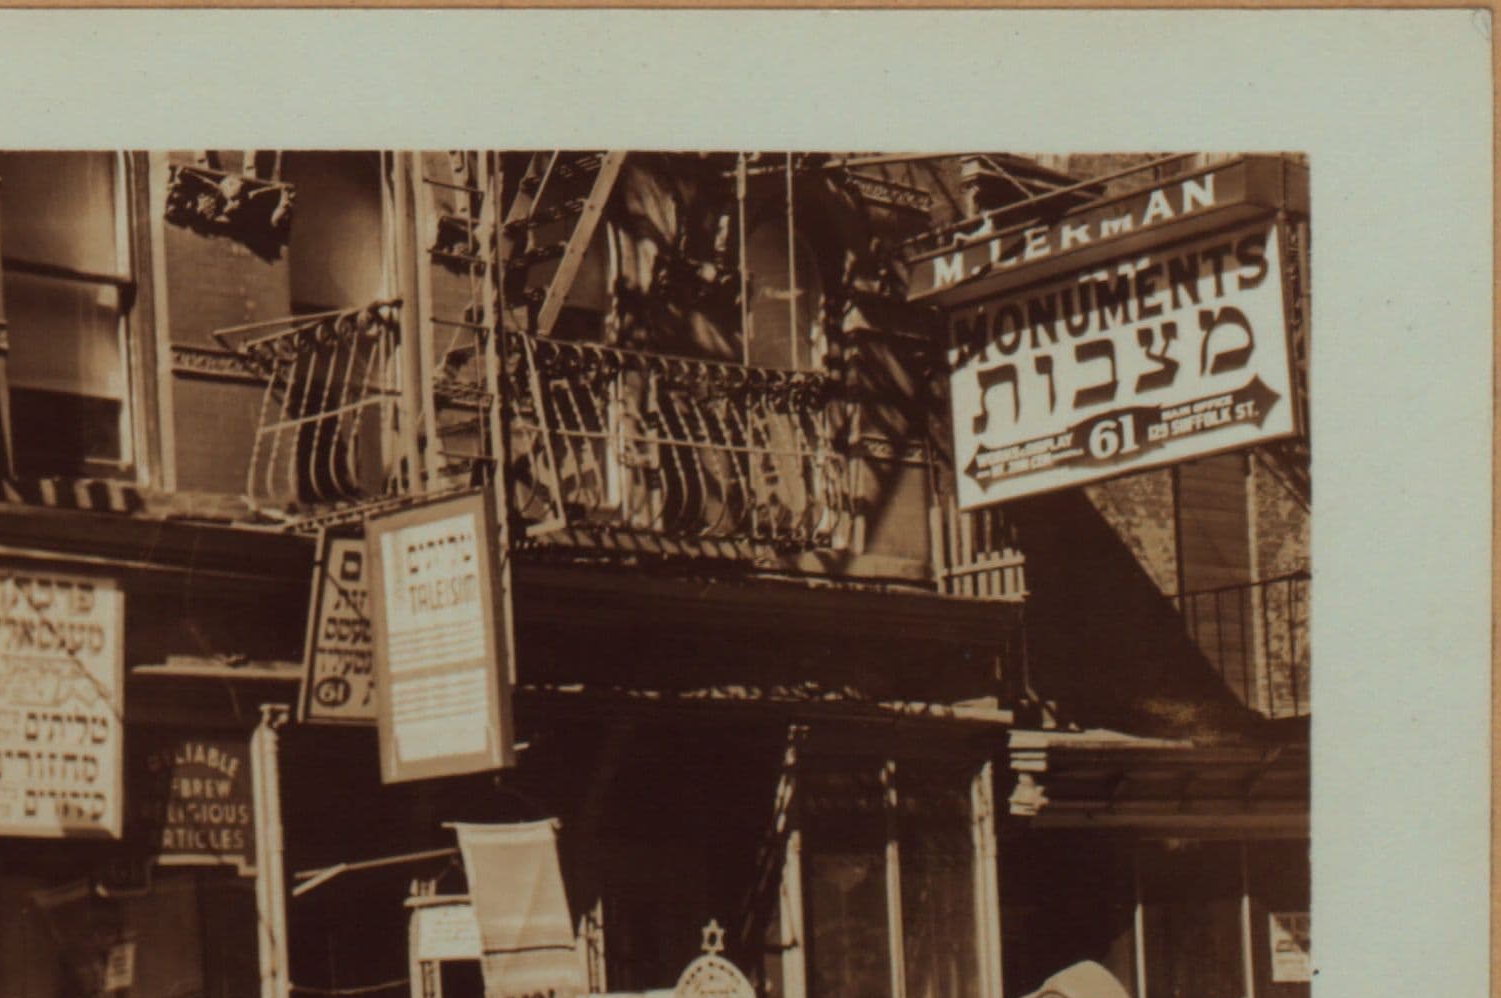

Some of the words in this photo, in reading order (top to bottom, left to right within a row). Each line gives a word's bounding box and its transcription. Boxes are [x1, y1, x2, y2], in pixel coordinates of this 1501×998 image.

[990, 173, 1216, 268] LEKMAN
[952, 233, 1270, 364] MONUMENTS
[973, 306, 1257, 435] מצבות
[1088, 413, 1140, 461] 61
[1171, 406, 1232, 437] SUFFOLK
[318, 681, 347, 704] 61
[25, 710, 109, 748] טליתים
[147, 742, 240, 778] LIABLE
[23, 788, 108, 824] סידורים
[167, 802, 250, 825] LIGIOUS
[160, 828, 245, 850] RTICLES
